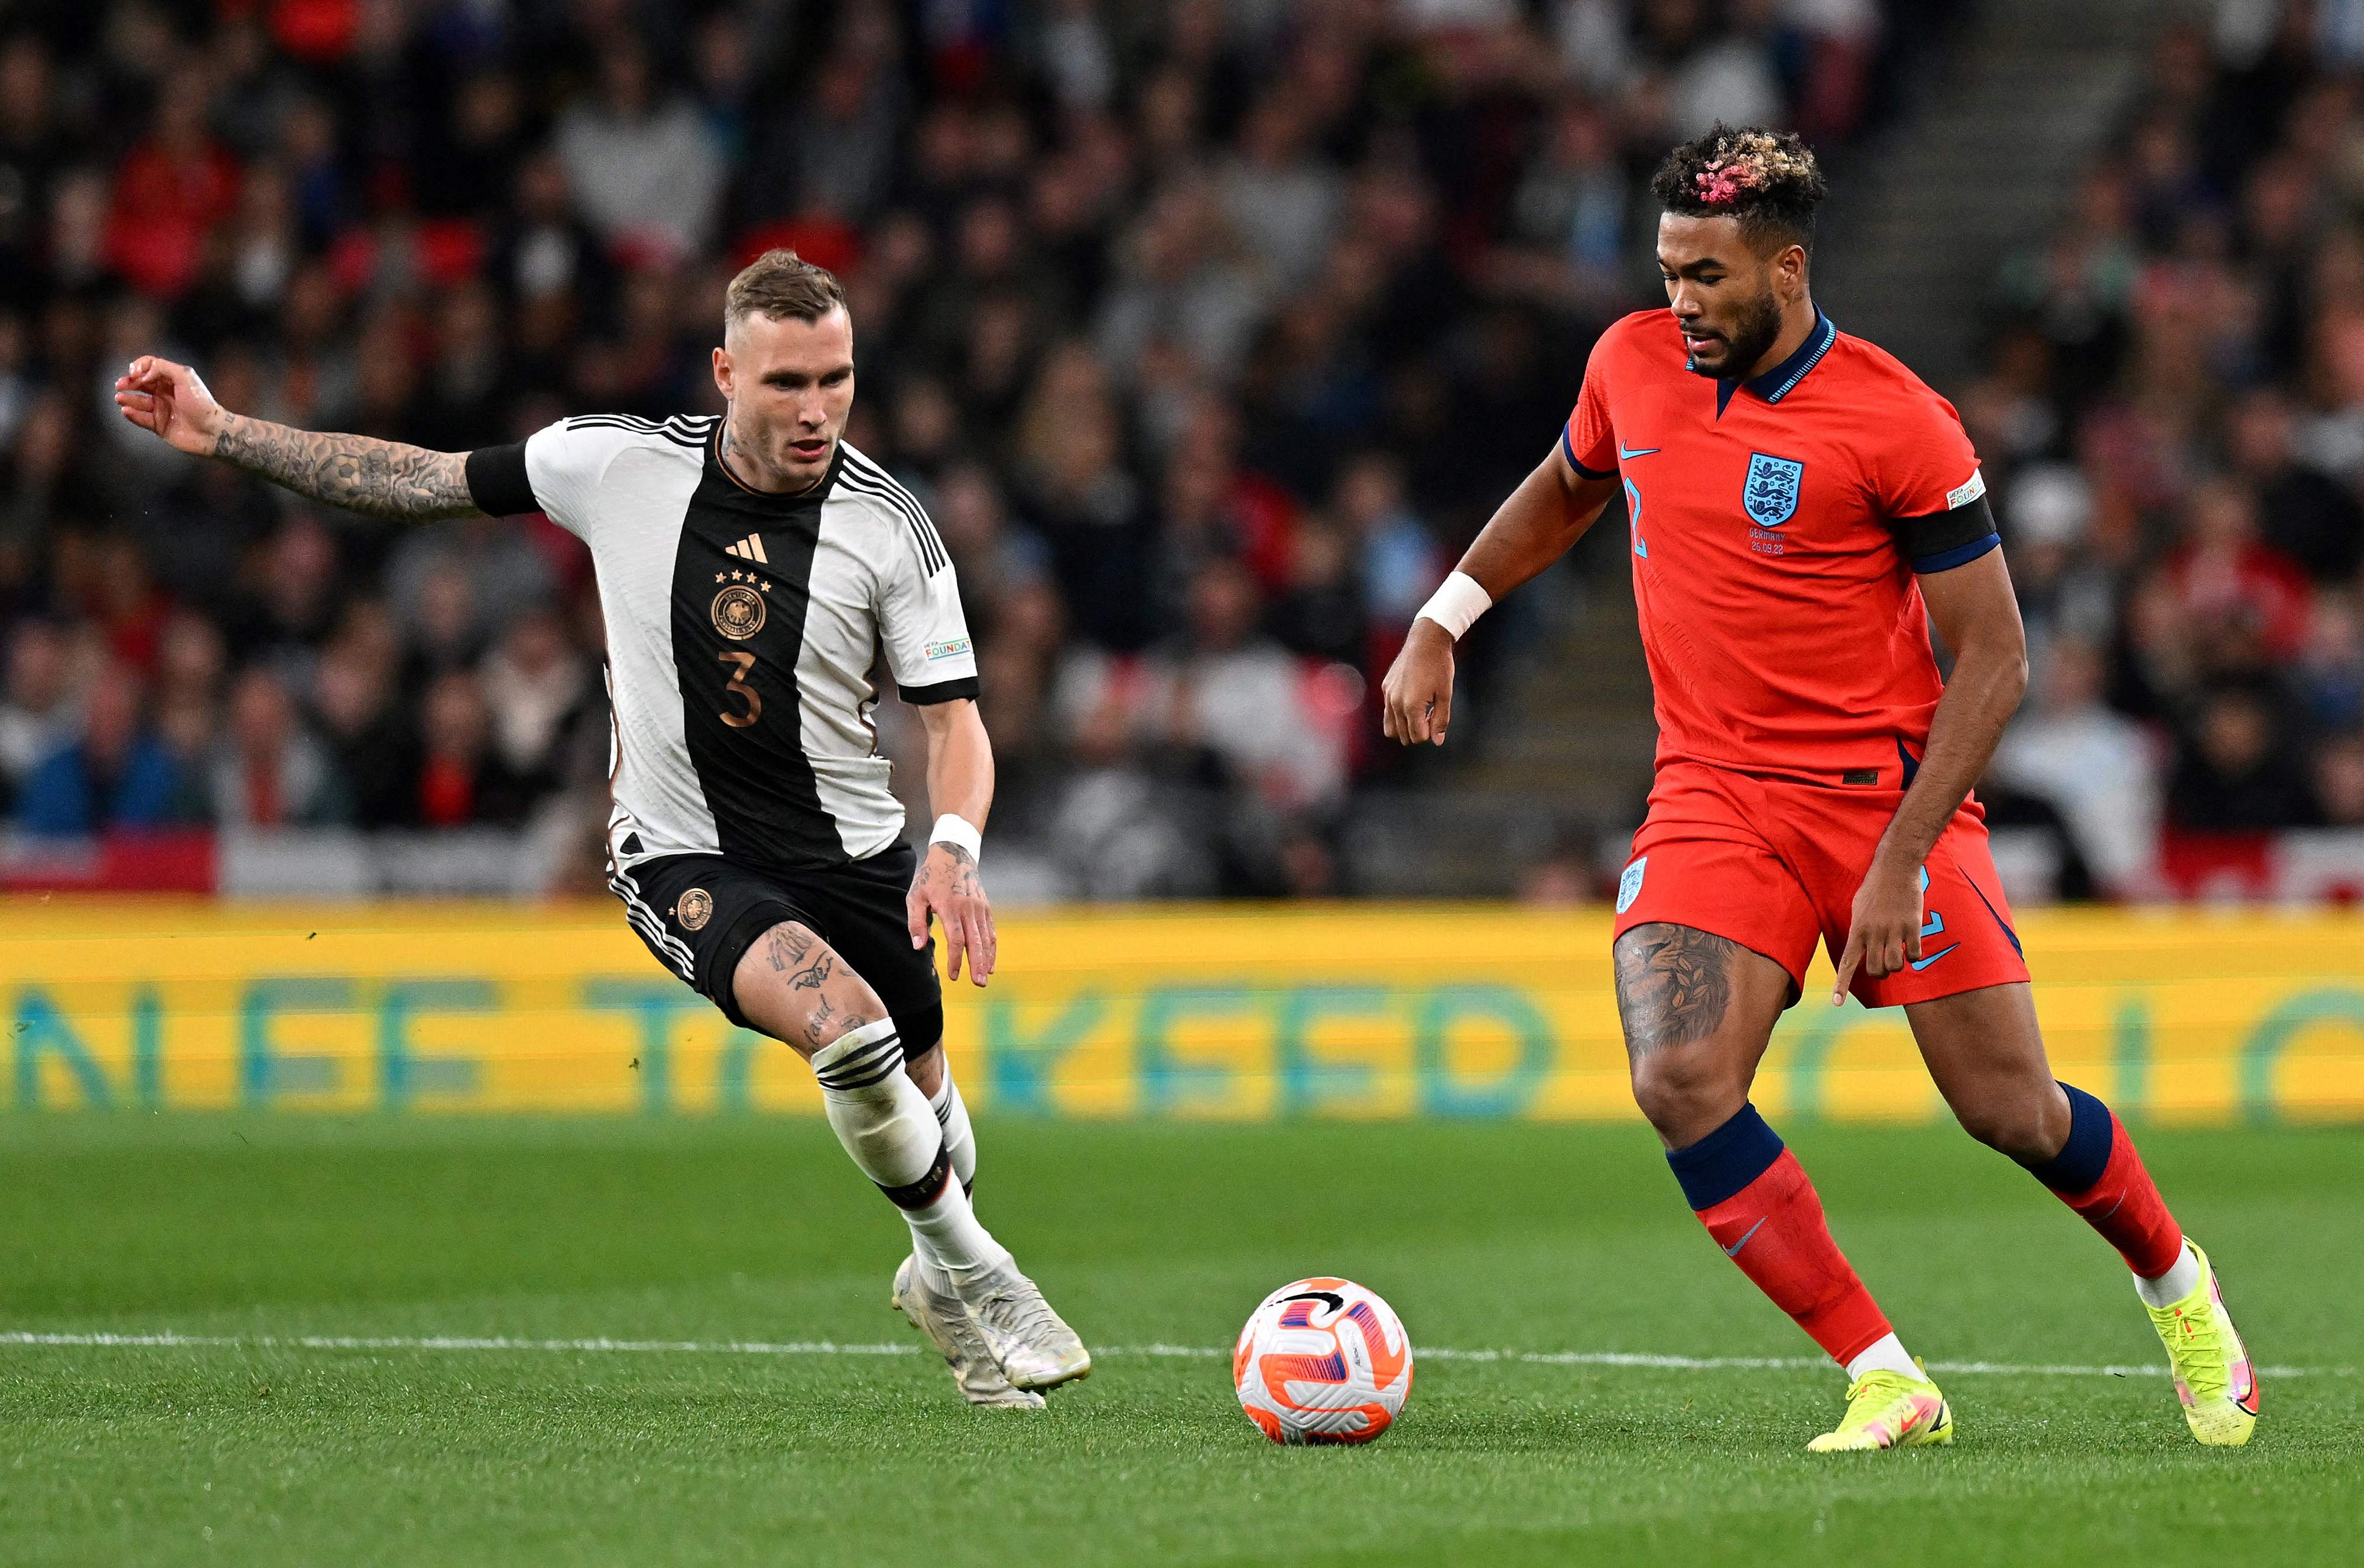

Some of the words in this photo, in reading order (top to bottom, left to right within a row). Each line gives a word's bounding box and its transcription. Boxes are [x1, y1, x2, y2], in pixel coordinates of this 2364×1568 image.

[1624, 476, 1648, 559] 2
[1749, 527, 1786, 541] GERMANY
[1752, 541, 1783, 554] 26.09.22
[718, 651, 762, 728] 3
